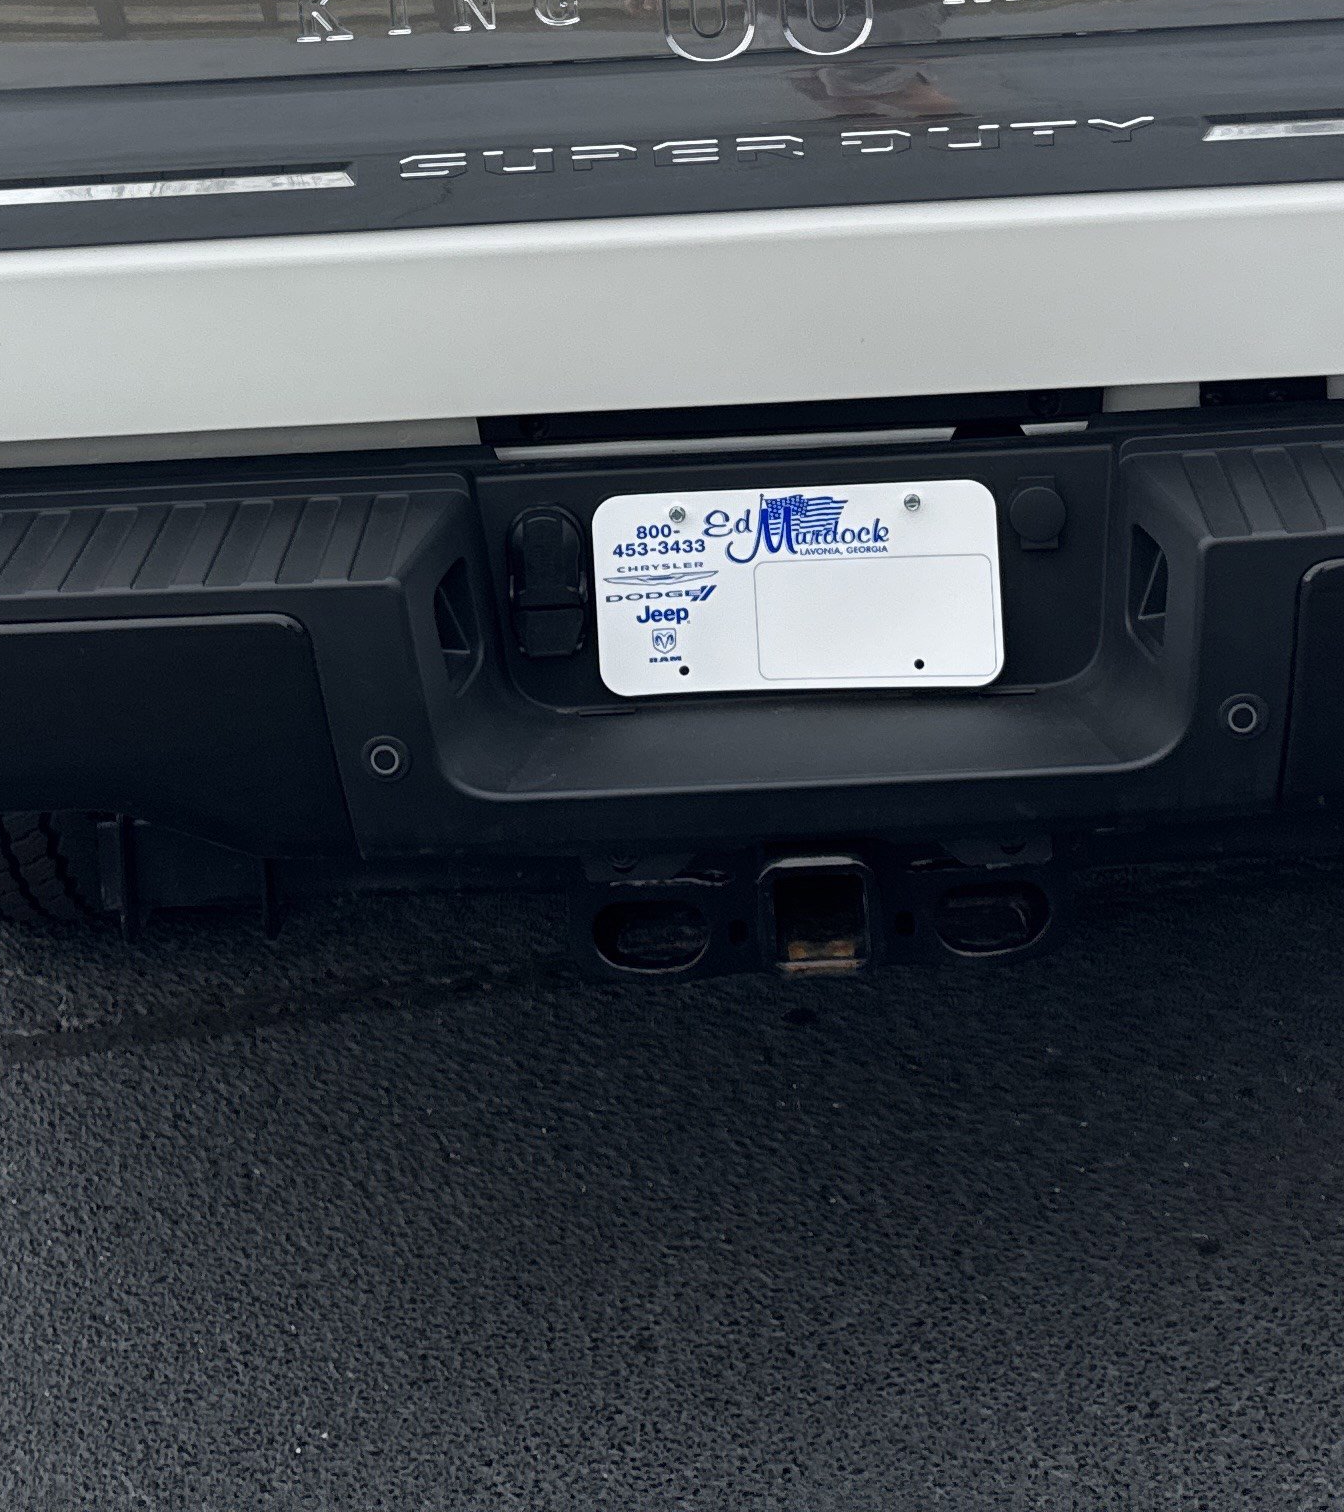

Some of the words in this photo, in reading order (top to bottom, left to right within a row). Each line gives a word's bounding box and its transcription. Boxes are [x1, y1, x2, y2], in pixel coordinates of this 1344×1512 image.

[399, 133, 805, 178] SUPER
[840, 114, 1155, 154] DUTY
[636, 524, 681, 540] 800-
[702, 509, 753, 538] Ed
[725, 505, 890, 564] Murdock
[612, 539, 706, 558] 453-3433
[846, 545, 888, 555] GEORGIA
[617, 561, 704, 574] CHRYSLER
[605, 589, 702, 603] DODGE
[636, 605, 689, 625] Jeep
